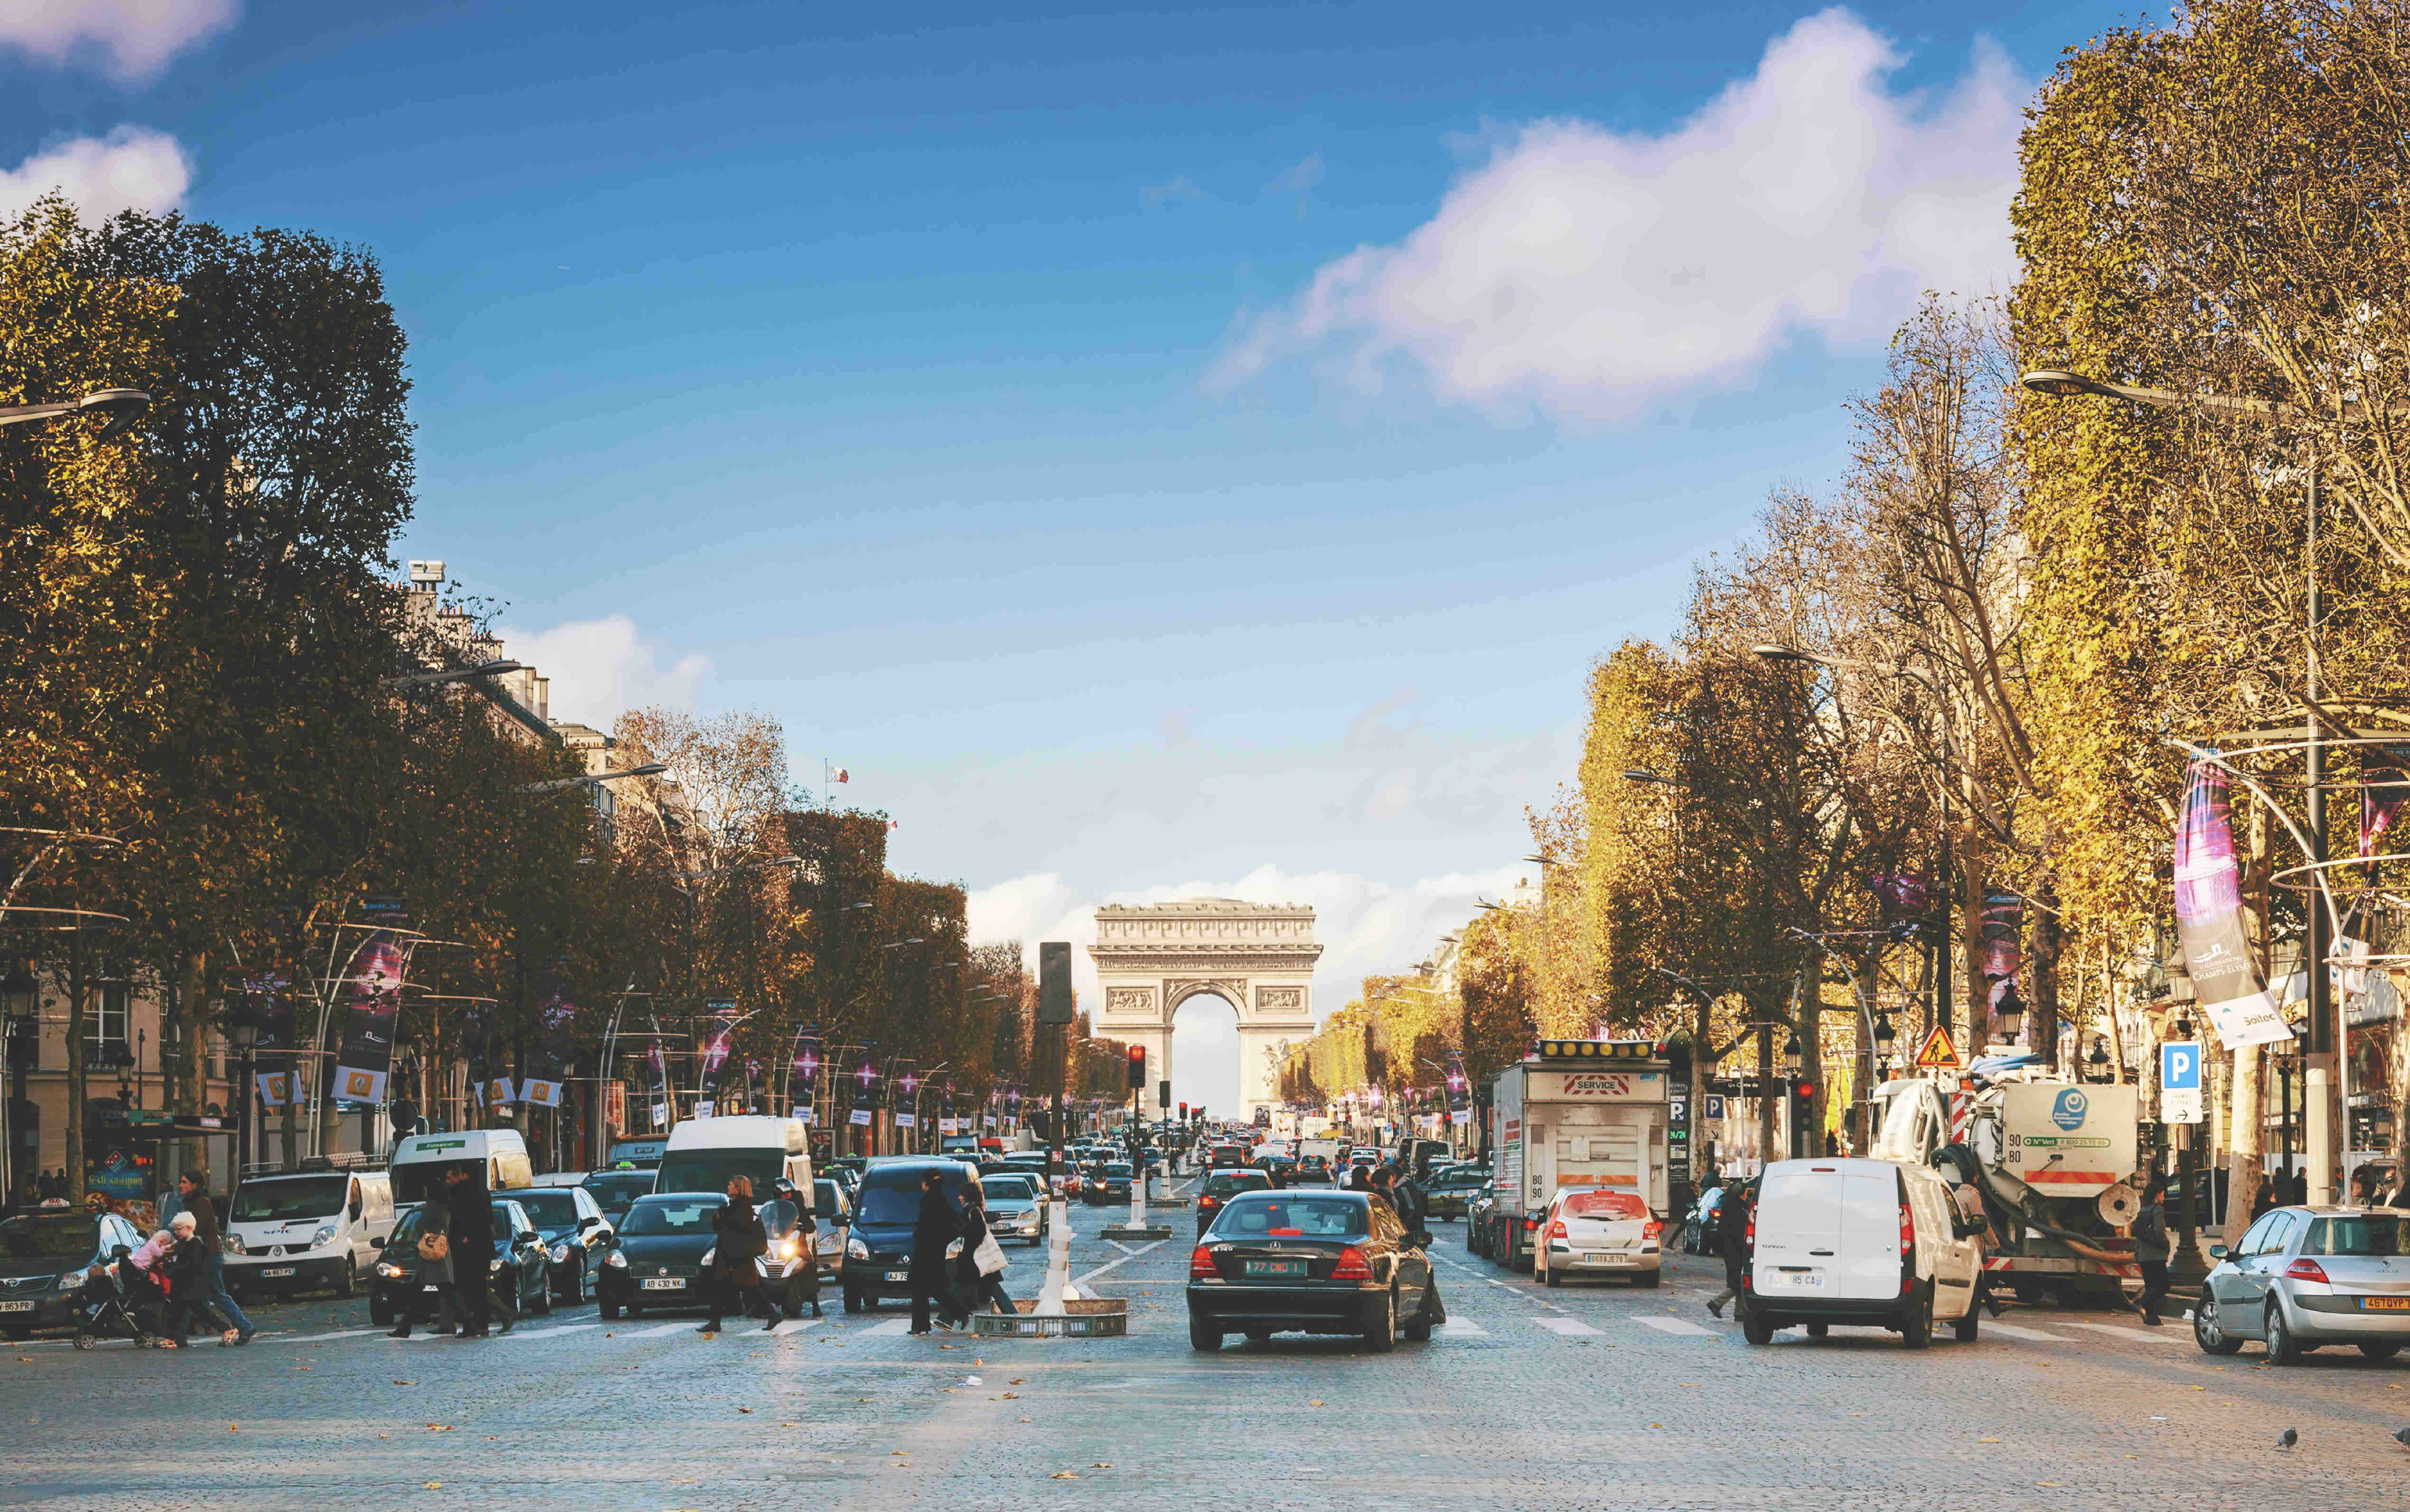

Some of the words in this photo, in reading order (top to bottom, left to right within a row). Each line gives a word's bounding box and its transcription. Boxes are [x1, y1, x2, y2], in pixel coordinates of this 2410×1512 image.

[2244, 1014, 2275, 1025] Soitec
[2173, 1052, 2190, 1082] P
[1670, 1102, 1684, 1120] P
[1710, 1099, 1719, 1115] P
[2009, 1134, 2021, 1146] 90
[2009, 1151, 2021, 1163] 80
[1533, 1175, 1542, 1185] 80
[1533, 1188, 1542, 1198] 90
[1254, 1262, 1266, 1271] 77
